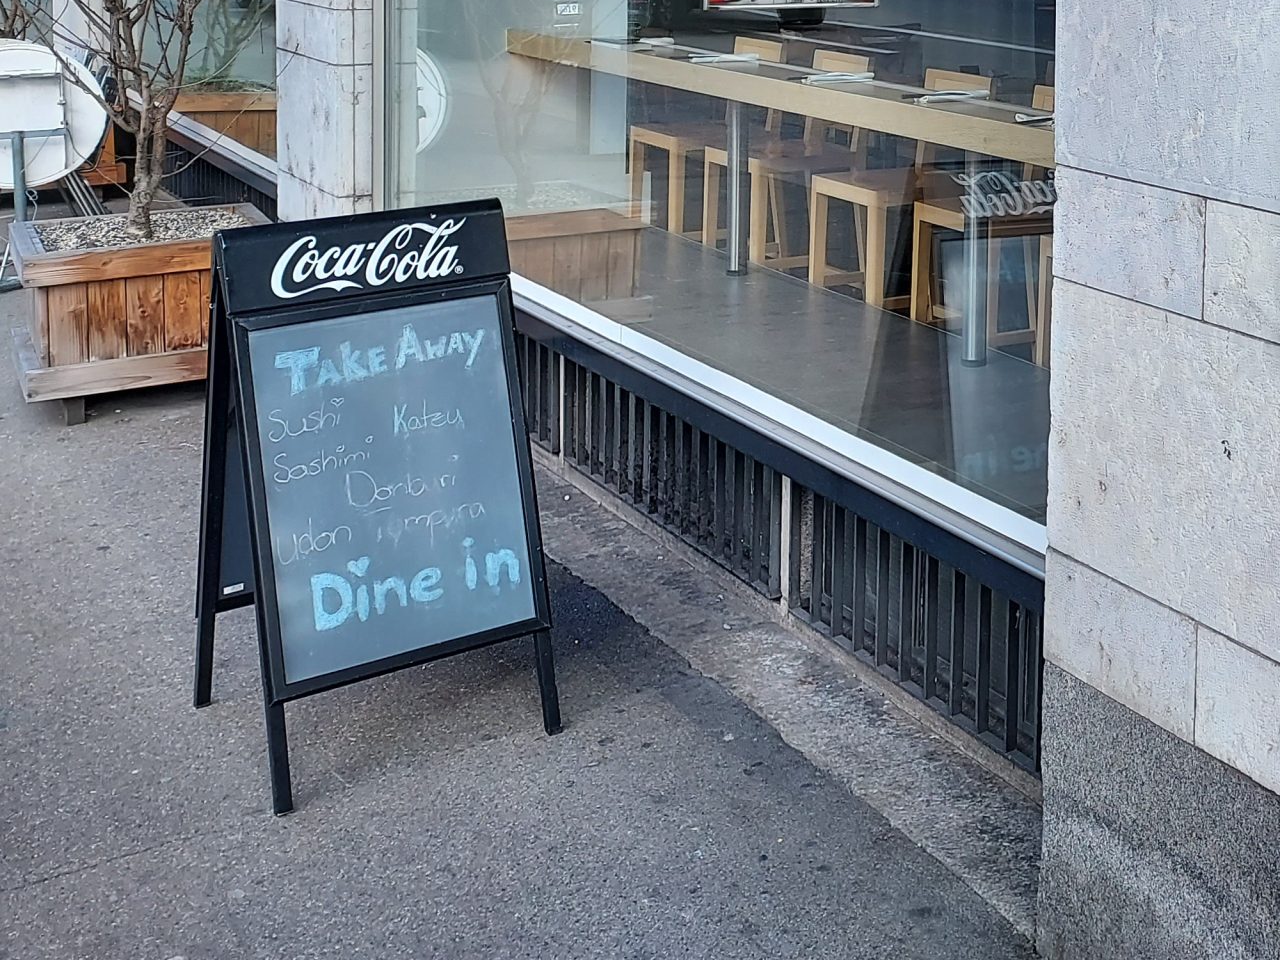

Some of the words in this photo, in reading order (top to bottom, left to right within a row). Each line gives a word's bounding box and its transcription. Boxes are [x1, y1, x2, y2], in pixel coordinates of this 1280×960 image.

[270, 216, 467, 299] Coca-Cola
[267, 397, 345, 442] Sushi
[273, 435, 373, 483] Sashimi
[344, 454, 459, 508] Donbri
[274, 517, 353, 566] Udon
[310, 556, 443, 632] Dine
[463, 537, 521, 590] in
